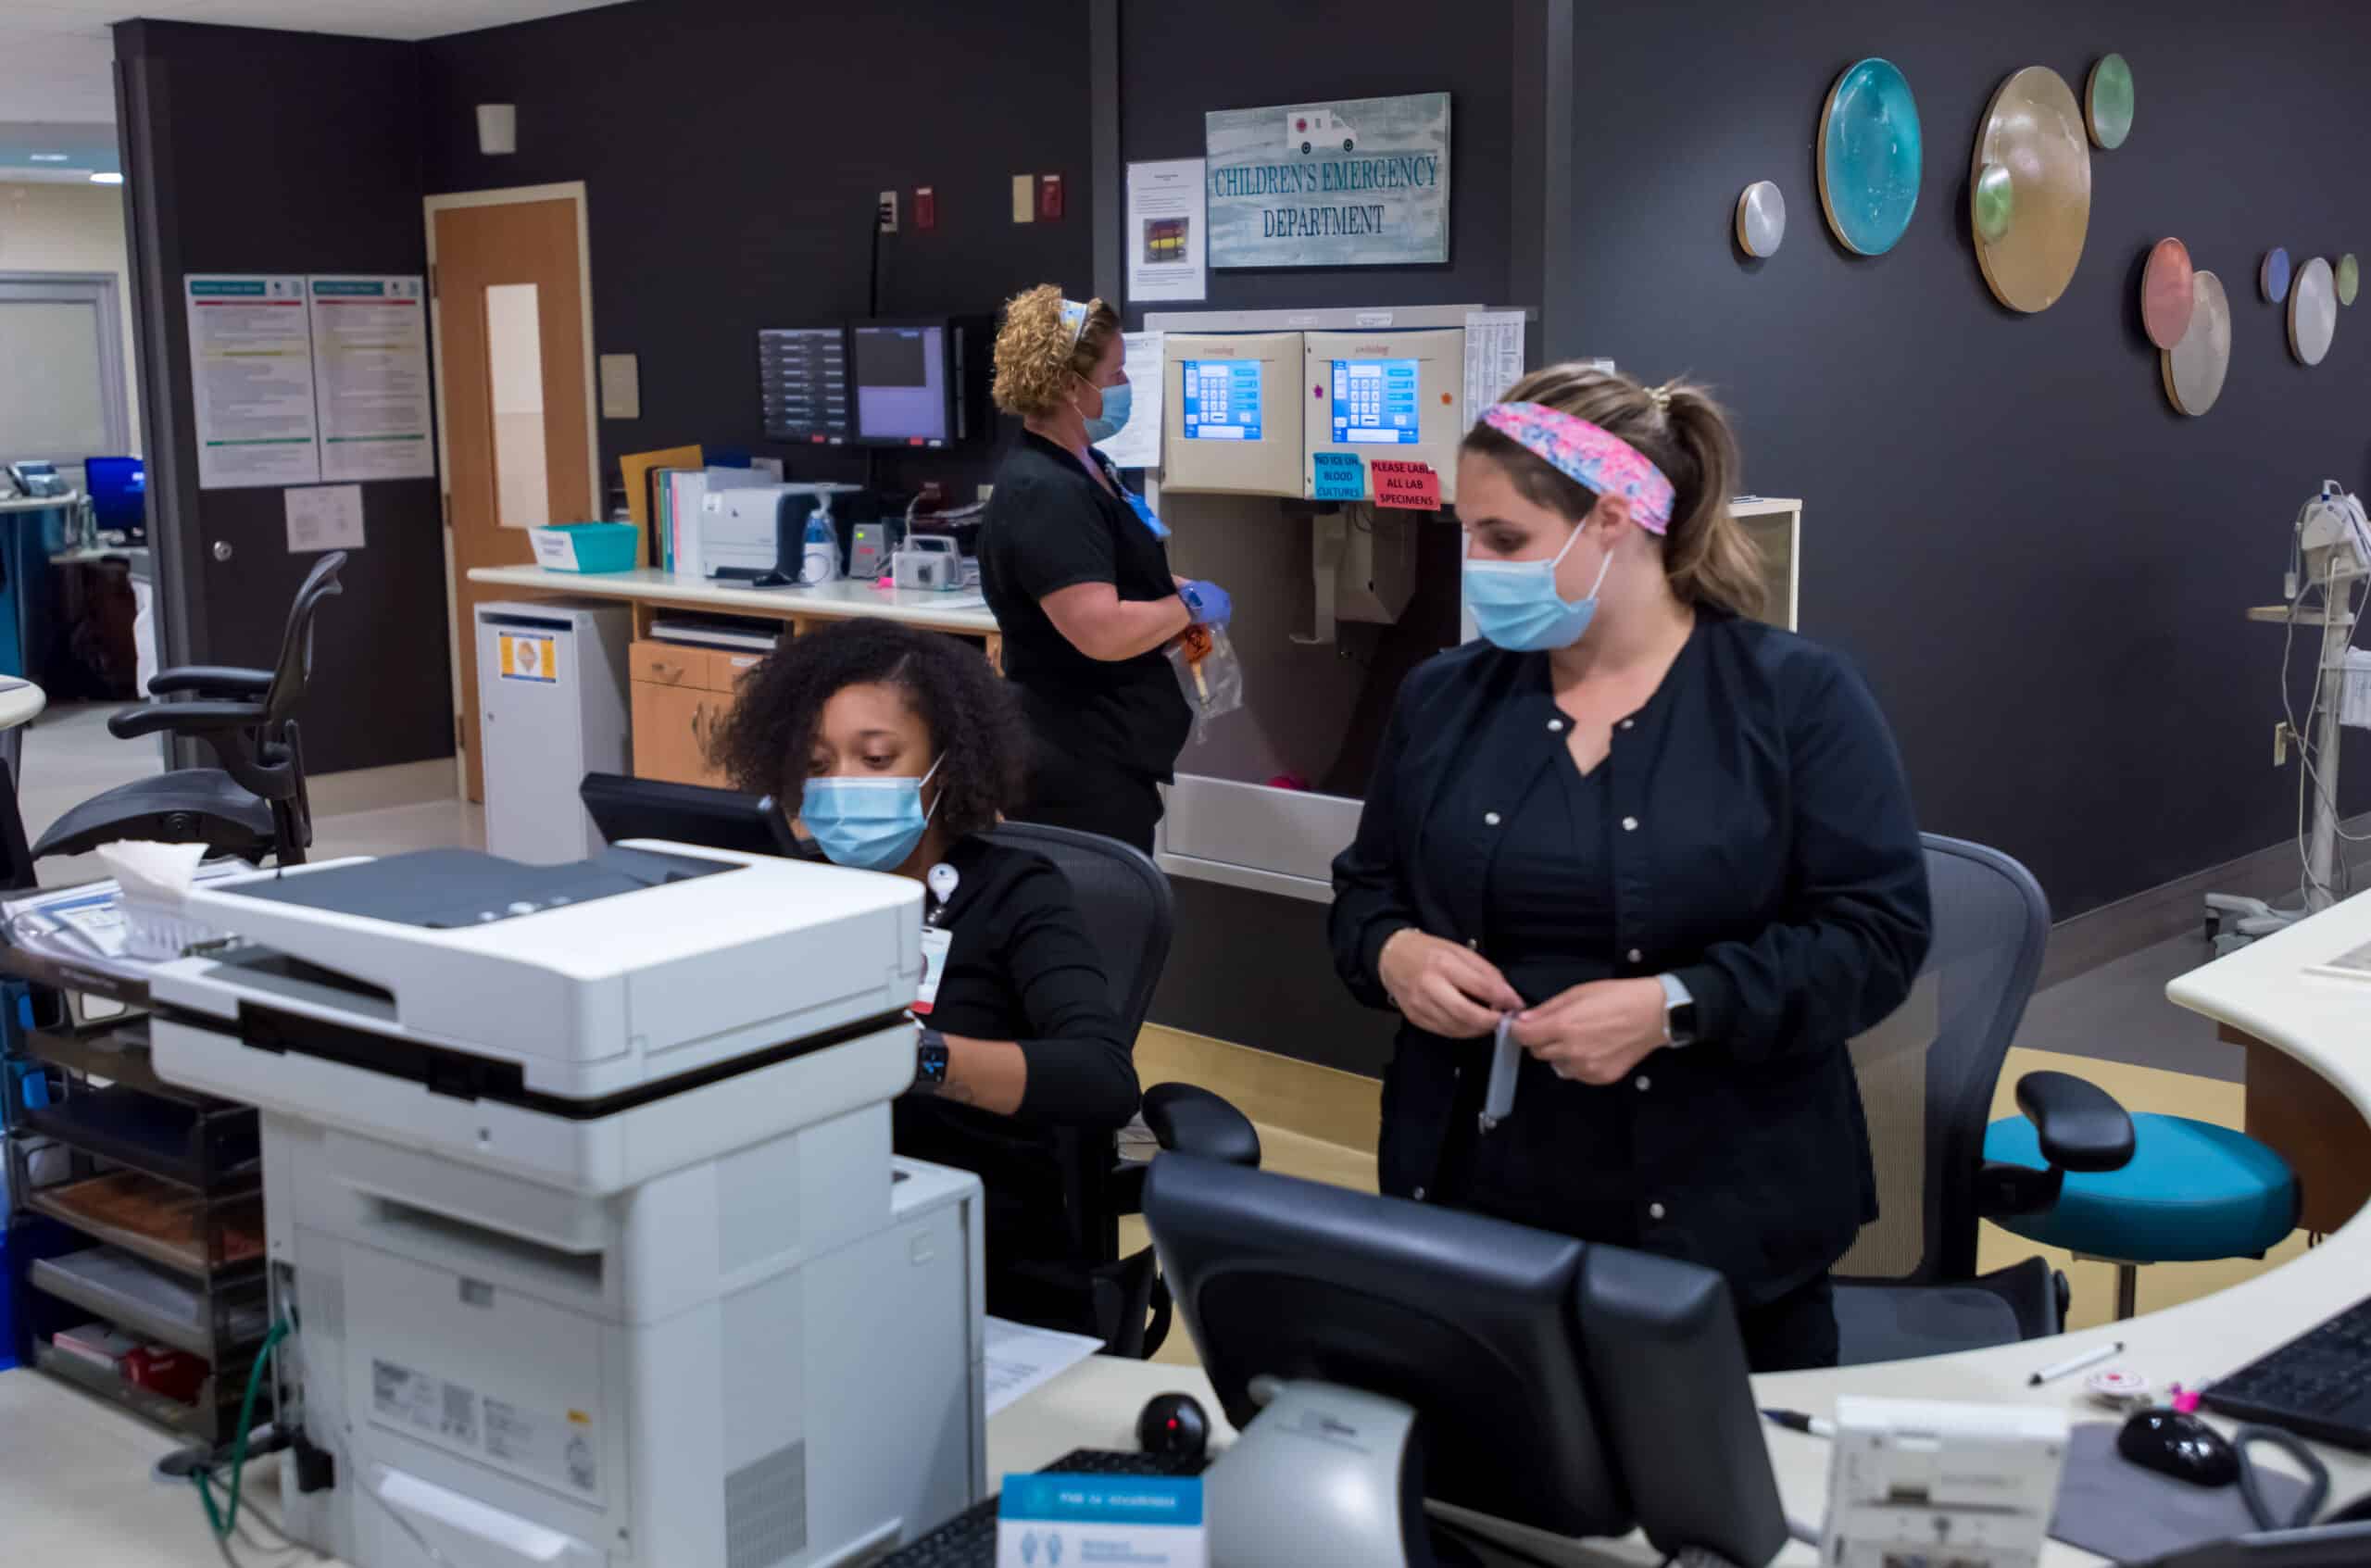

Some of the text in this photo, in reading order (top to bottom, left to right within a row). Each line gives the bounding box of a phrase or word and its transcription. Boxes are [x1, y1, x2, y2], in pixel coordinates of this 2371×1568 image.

[1214, 155, 1437, 197] CHILDREN'S EMERGENCY
[1262, 205, 1385, 238] DEPARTMENT
[1372, 461, 1405, 473] PLEASE
[1323, 470, 1353, 482] BLOOD
[1386, 478, 1424, 490] ALL LAB
[1379, 493, 1434, 505] SPECIMENS
